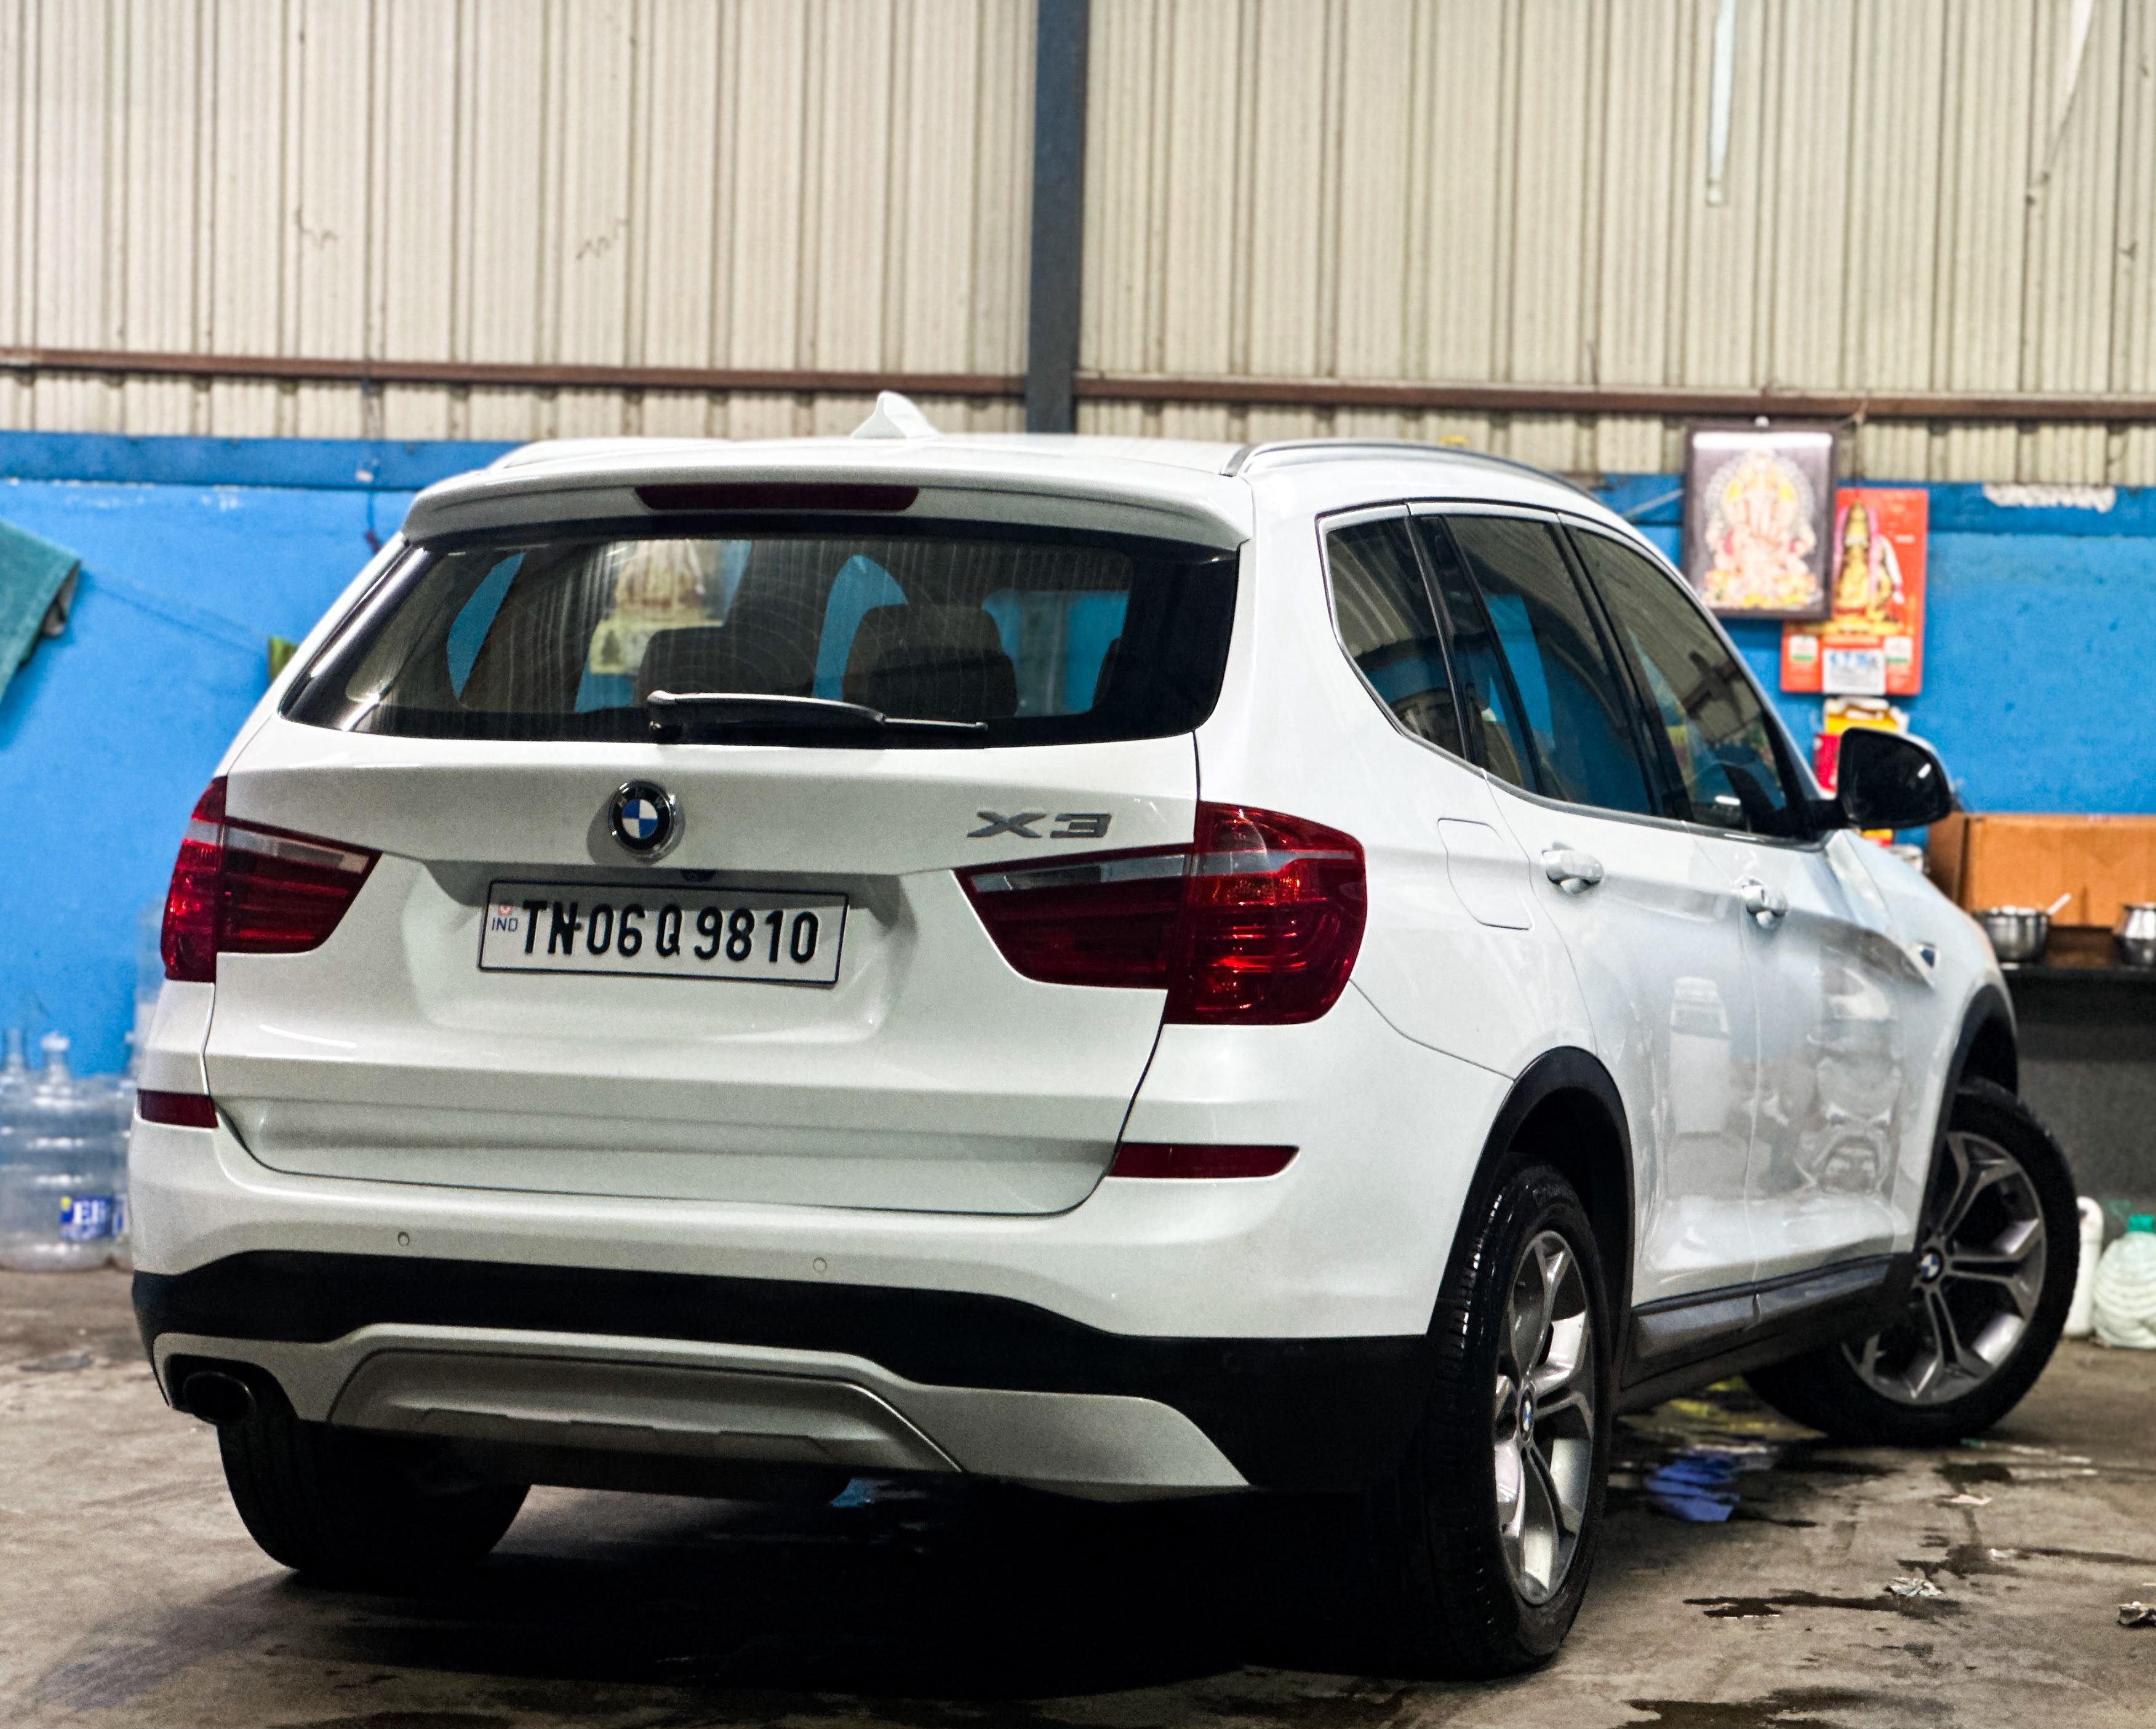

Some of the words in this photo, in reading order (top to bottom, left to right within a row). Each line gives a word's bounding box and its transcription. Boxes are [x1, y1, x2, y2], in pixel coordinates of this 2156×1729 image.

[967, 811, 1112, 839] X3
[491, 917, 519, 932] IND
[693, 906, 819, 963] 9810
